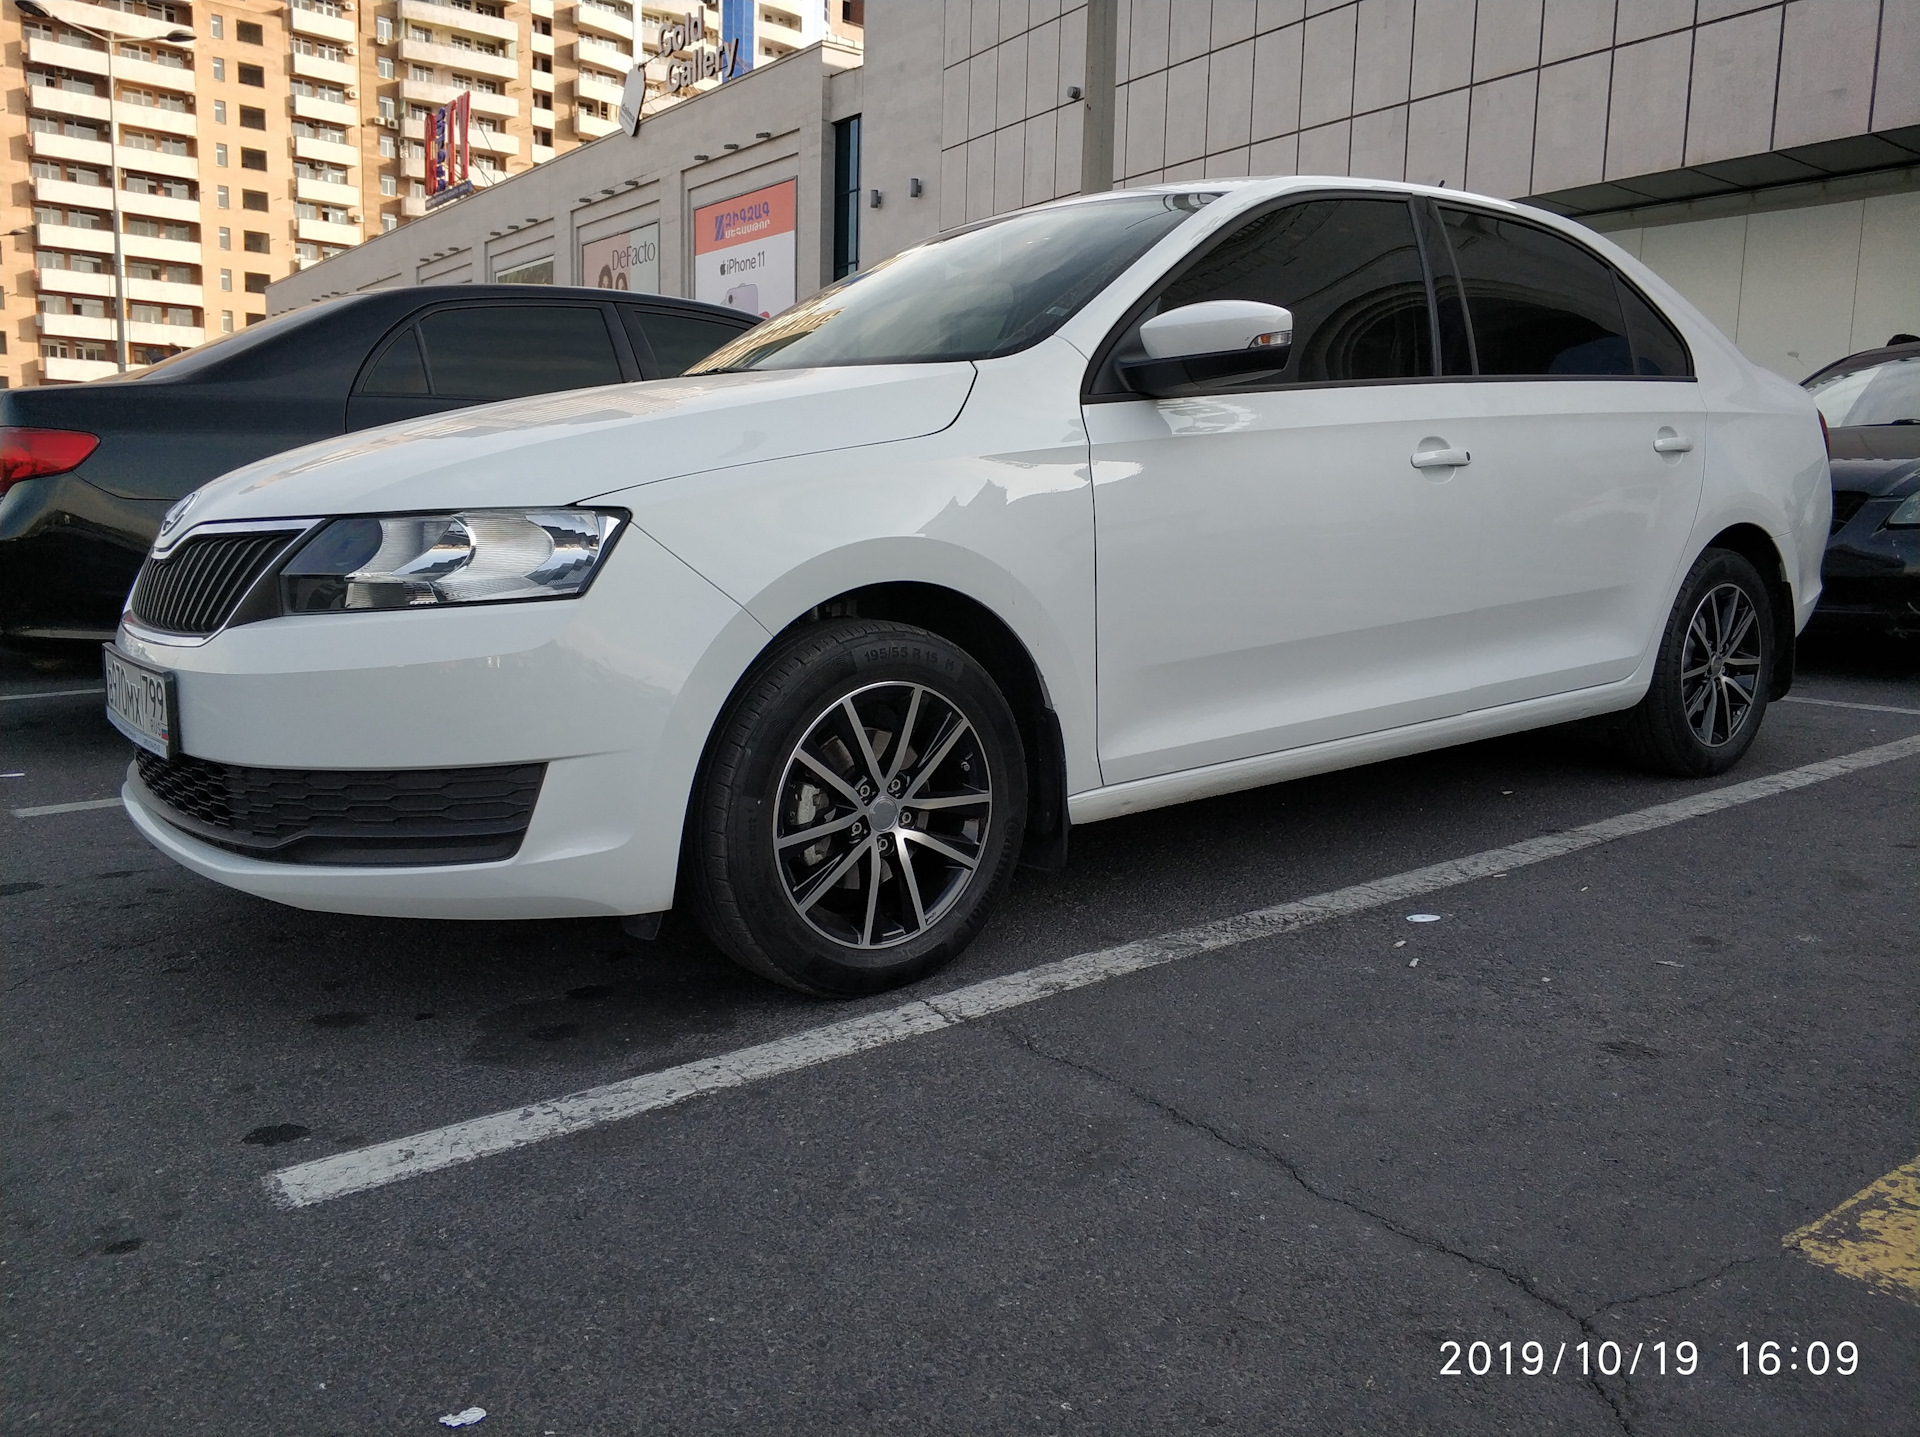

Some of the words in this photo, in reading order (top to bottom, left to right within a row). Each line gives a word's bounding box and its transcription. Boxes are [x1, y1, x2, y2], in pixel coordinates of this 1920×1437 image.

[657, 5, 704, 57] Gold
[666, 38, 738, 92] Gallery
[612, 241, 656, 271] DeFacto
[726, 256, 757, 275] iPhone
[757, 251, 765, 268] 11
[864, 646, 909, 662] 195/55
[926, 650, 938, 664] 15
[141, 673, 164, 721] 799
